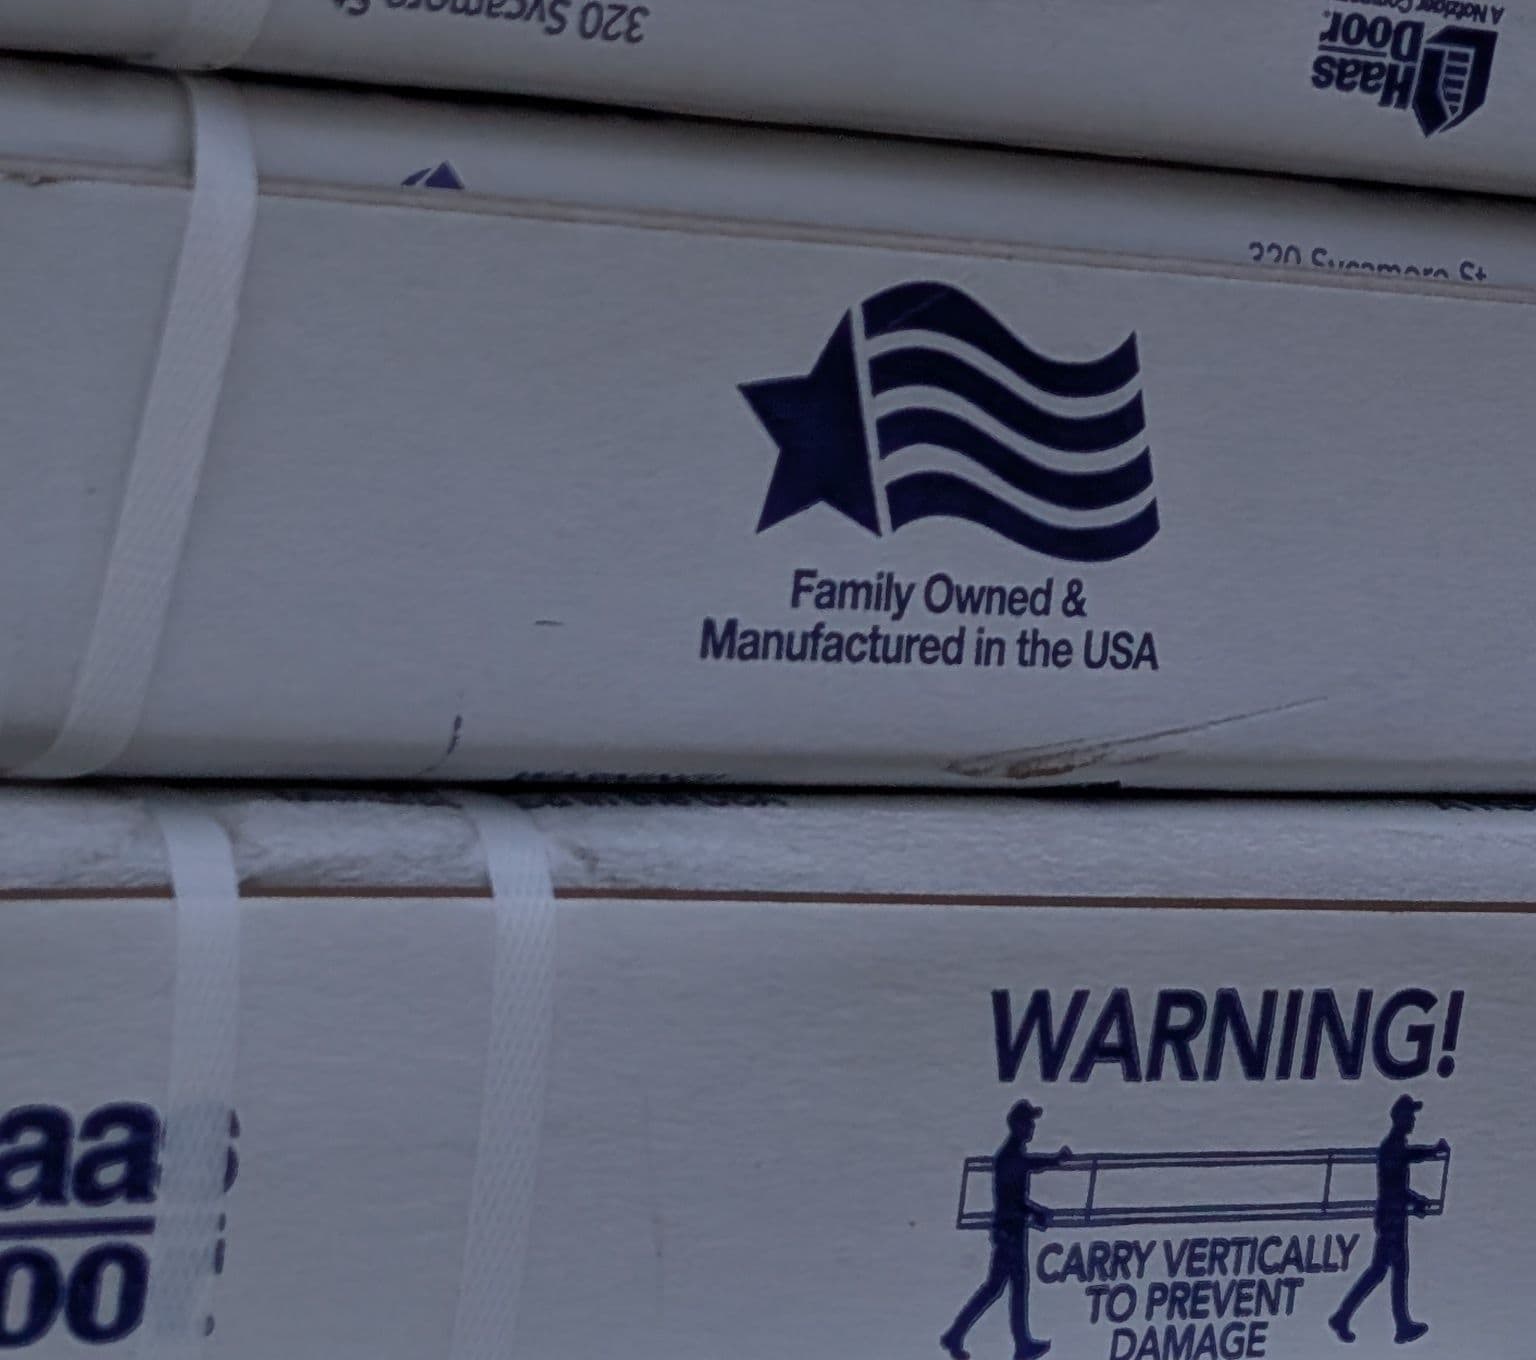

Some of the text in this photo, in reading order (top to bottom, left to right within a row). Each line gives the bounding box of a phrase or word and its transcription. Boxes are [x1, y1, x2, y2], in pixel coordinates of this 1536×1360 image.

[578, 0, 650, 43] 320
[1491, 5, 1504, 25] A
[1311, 54, 1418, 111] Haas
[790, 568, 1088, 621] Family Owned &
[700, 616, 1160, 671] Manufactured in the USA
[990, 987, 1466, 1084] WARNING!
[1035, 1232, 1361, 1284] CARRY VERTICALLY
[1085, 1277, 1305, 1324] TO PREVENT
[1108, 1320, 1270, 1360] DAMAGE
